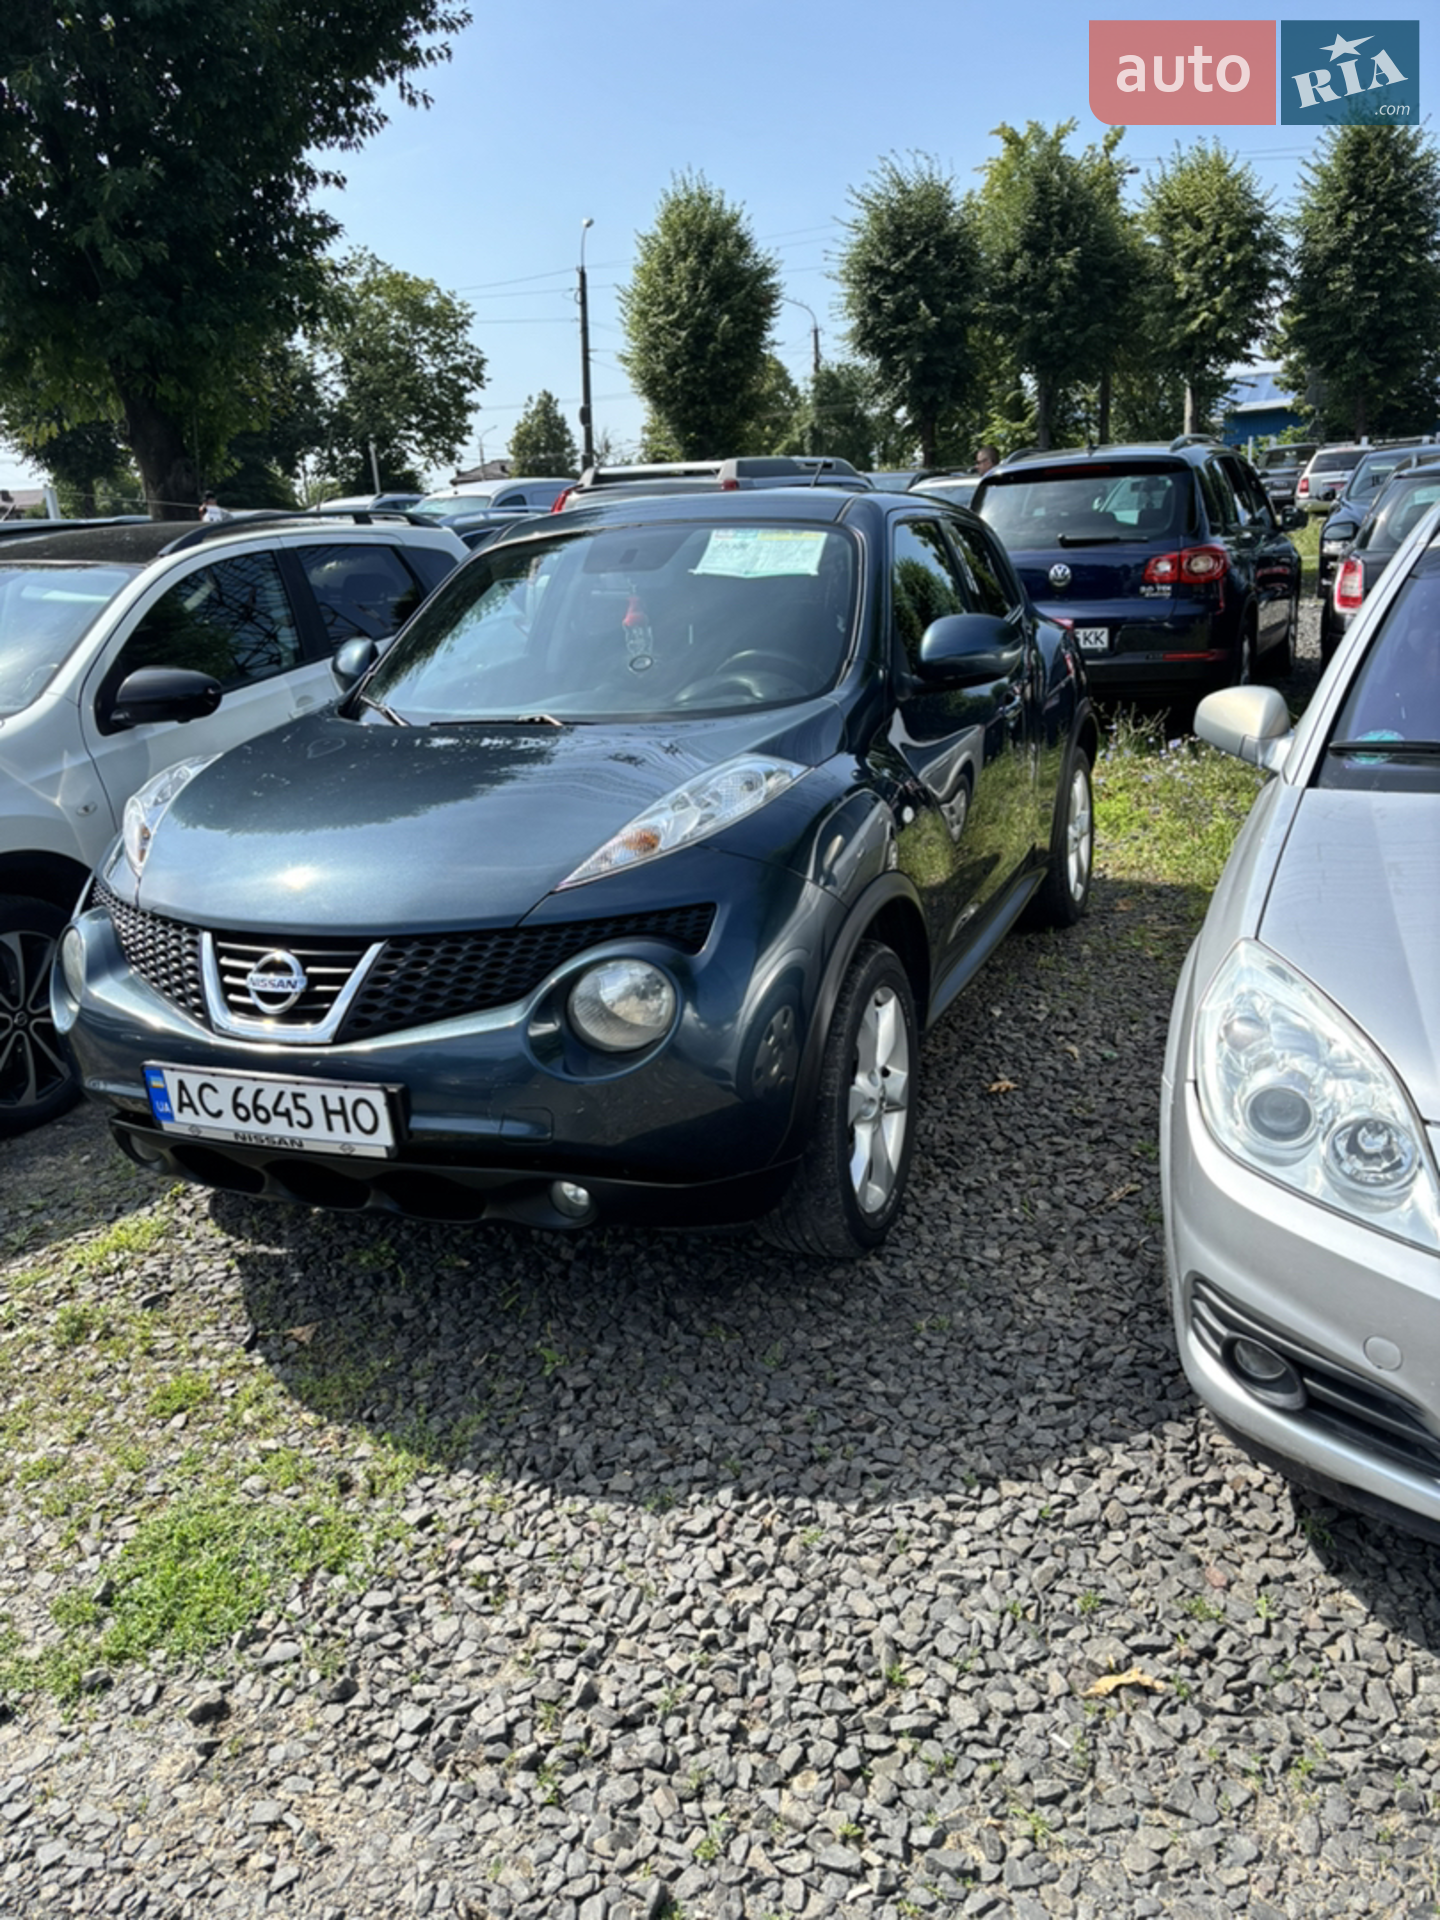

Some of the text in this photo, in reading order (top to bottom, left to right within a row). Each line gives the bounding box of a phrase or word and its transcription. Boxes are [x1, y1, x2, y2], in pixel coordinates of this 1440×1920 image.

[249, 977, 298, 990] NISSAN
[156, 1101, 171, 1113] UA
[177, 1078, 379, 1136] AC 6645 HO
[233, 1131, 305, 1148] NISSAN
